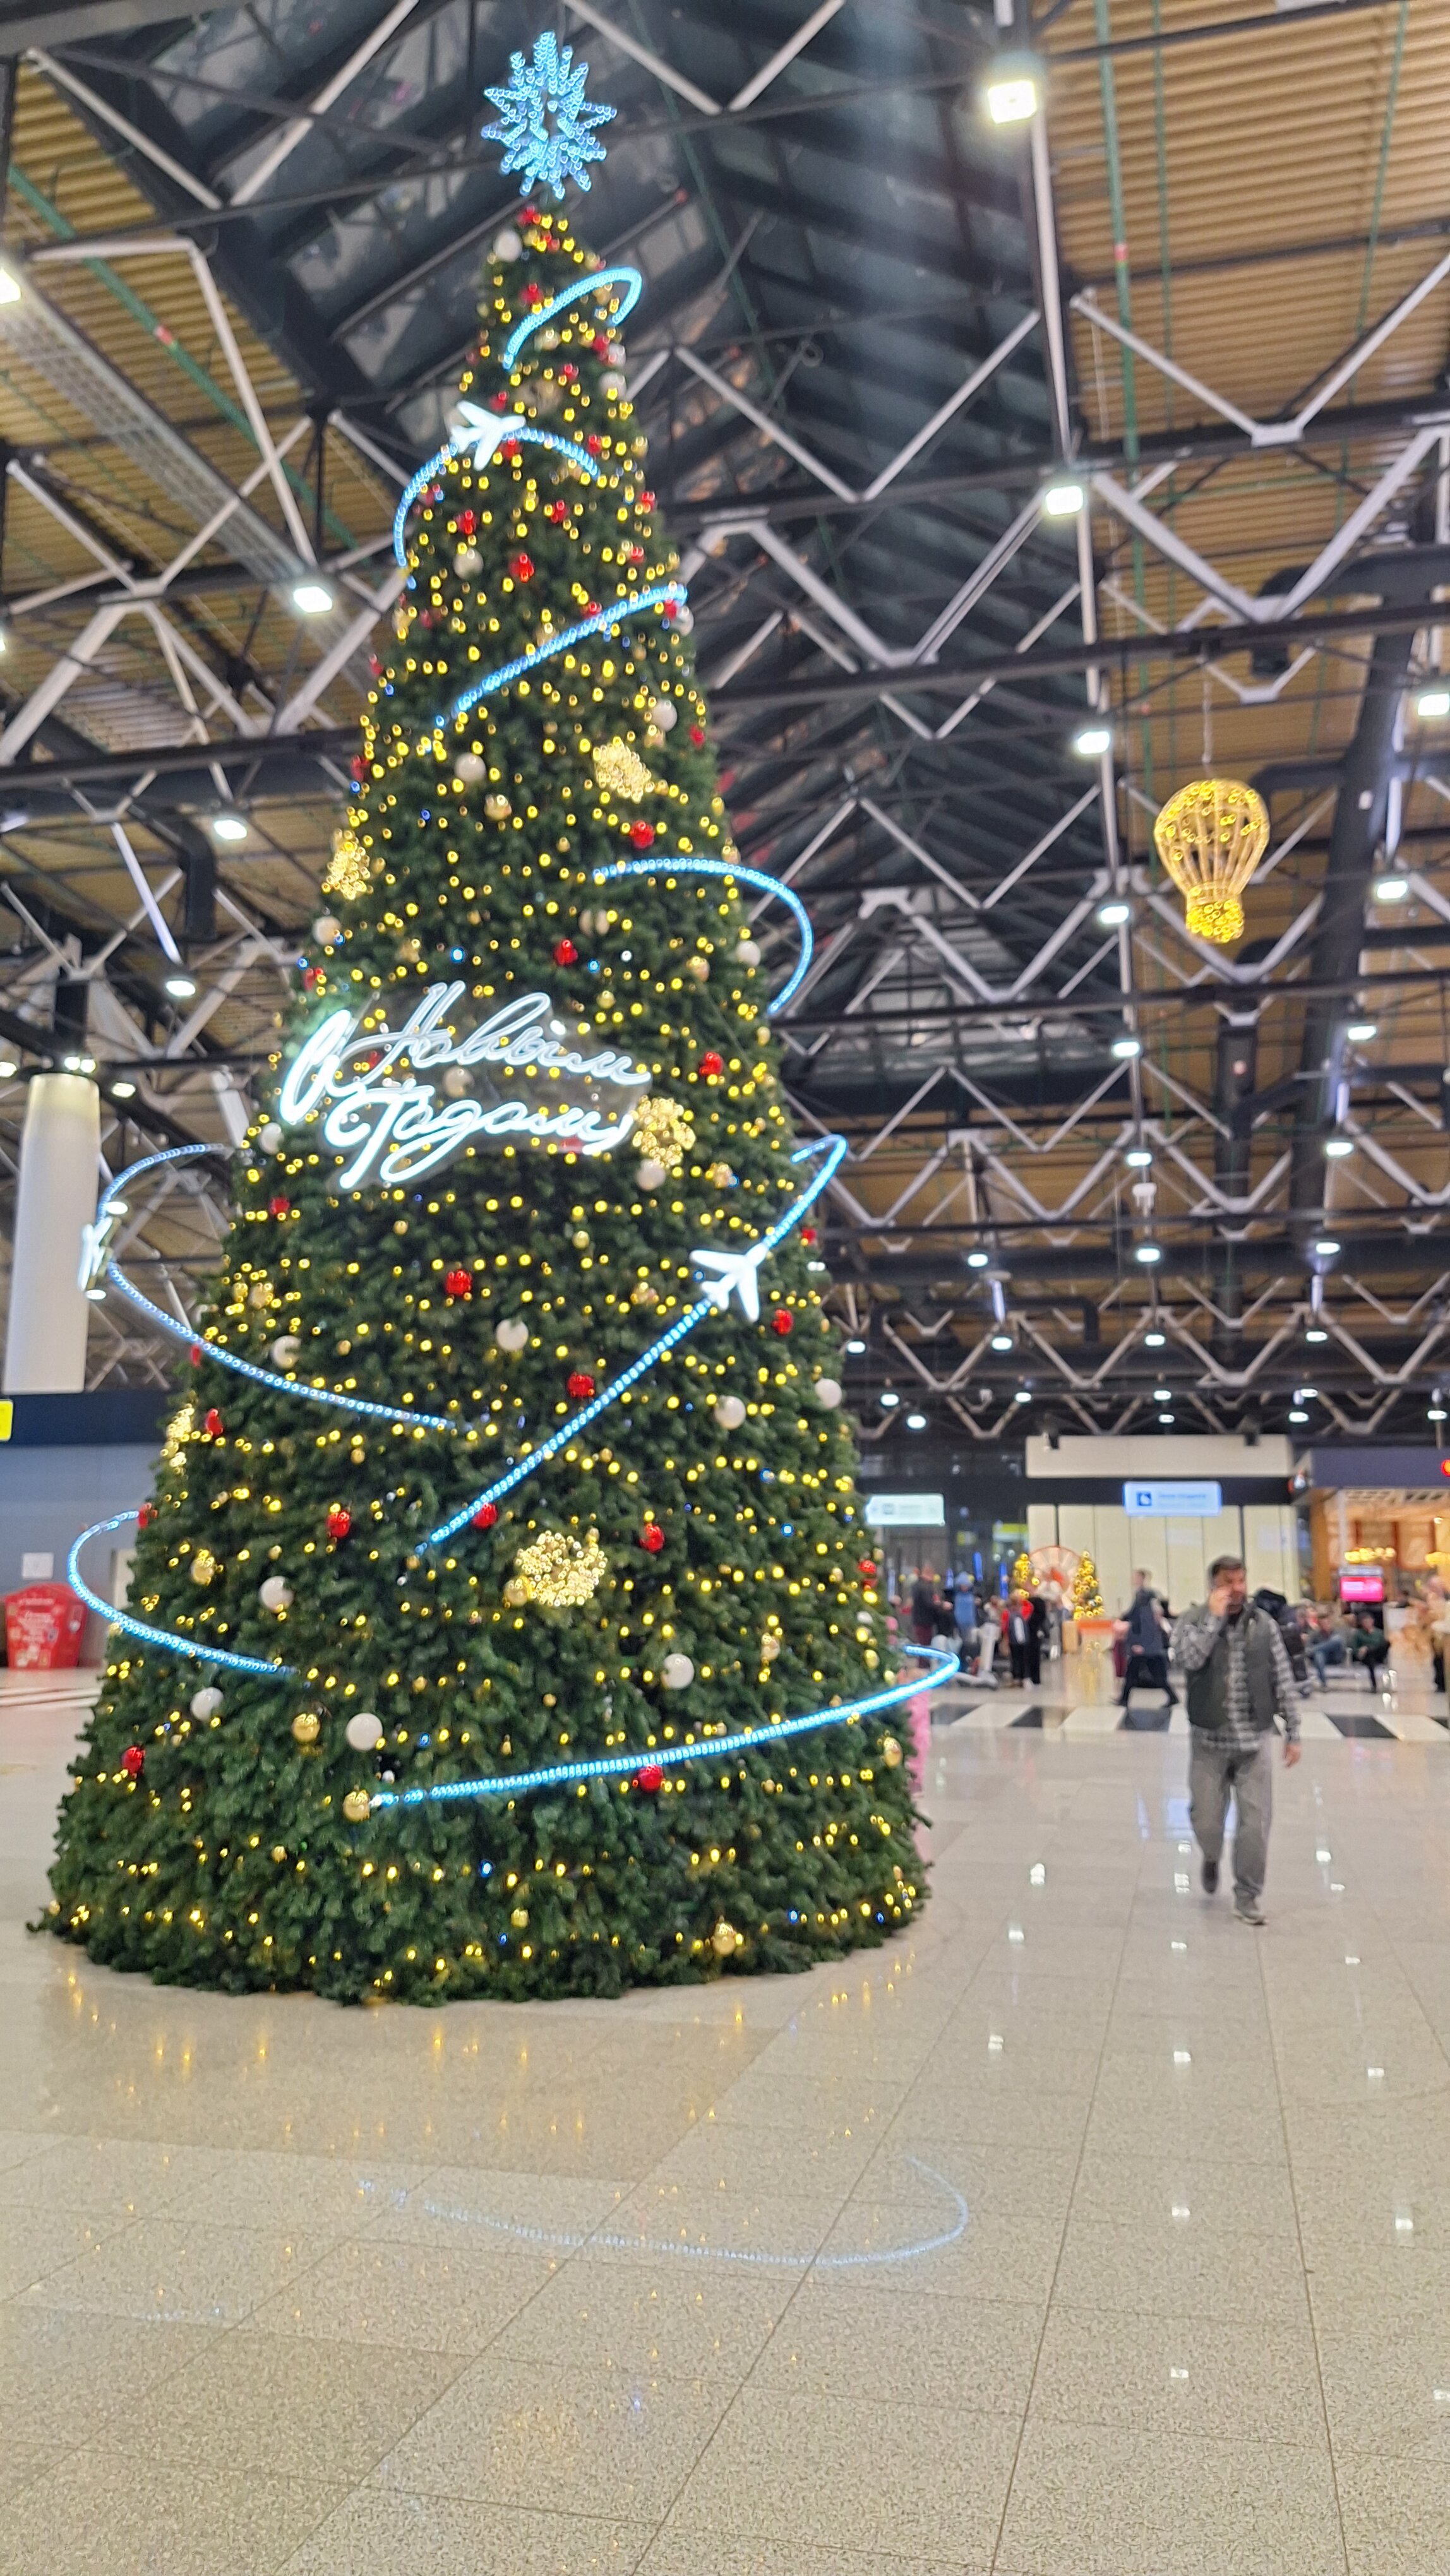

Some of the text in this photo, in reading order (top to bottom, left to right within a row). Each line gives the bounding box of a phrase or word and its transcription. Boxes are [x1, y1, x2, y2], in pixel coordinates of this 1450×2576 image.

[280, 979, 652, 1125] С Новым
[324, 1078, 633, 1190] Годом
